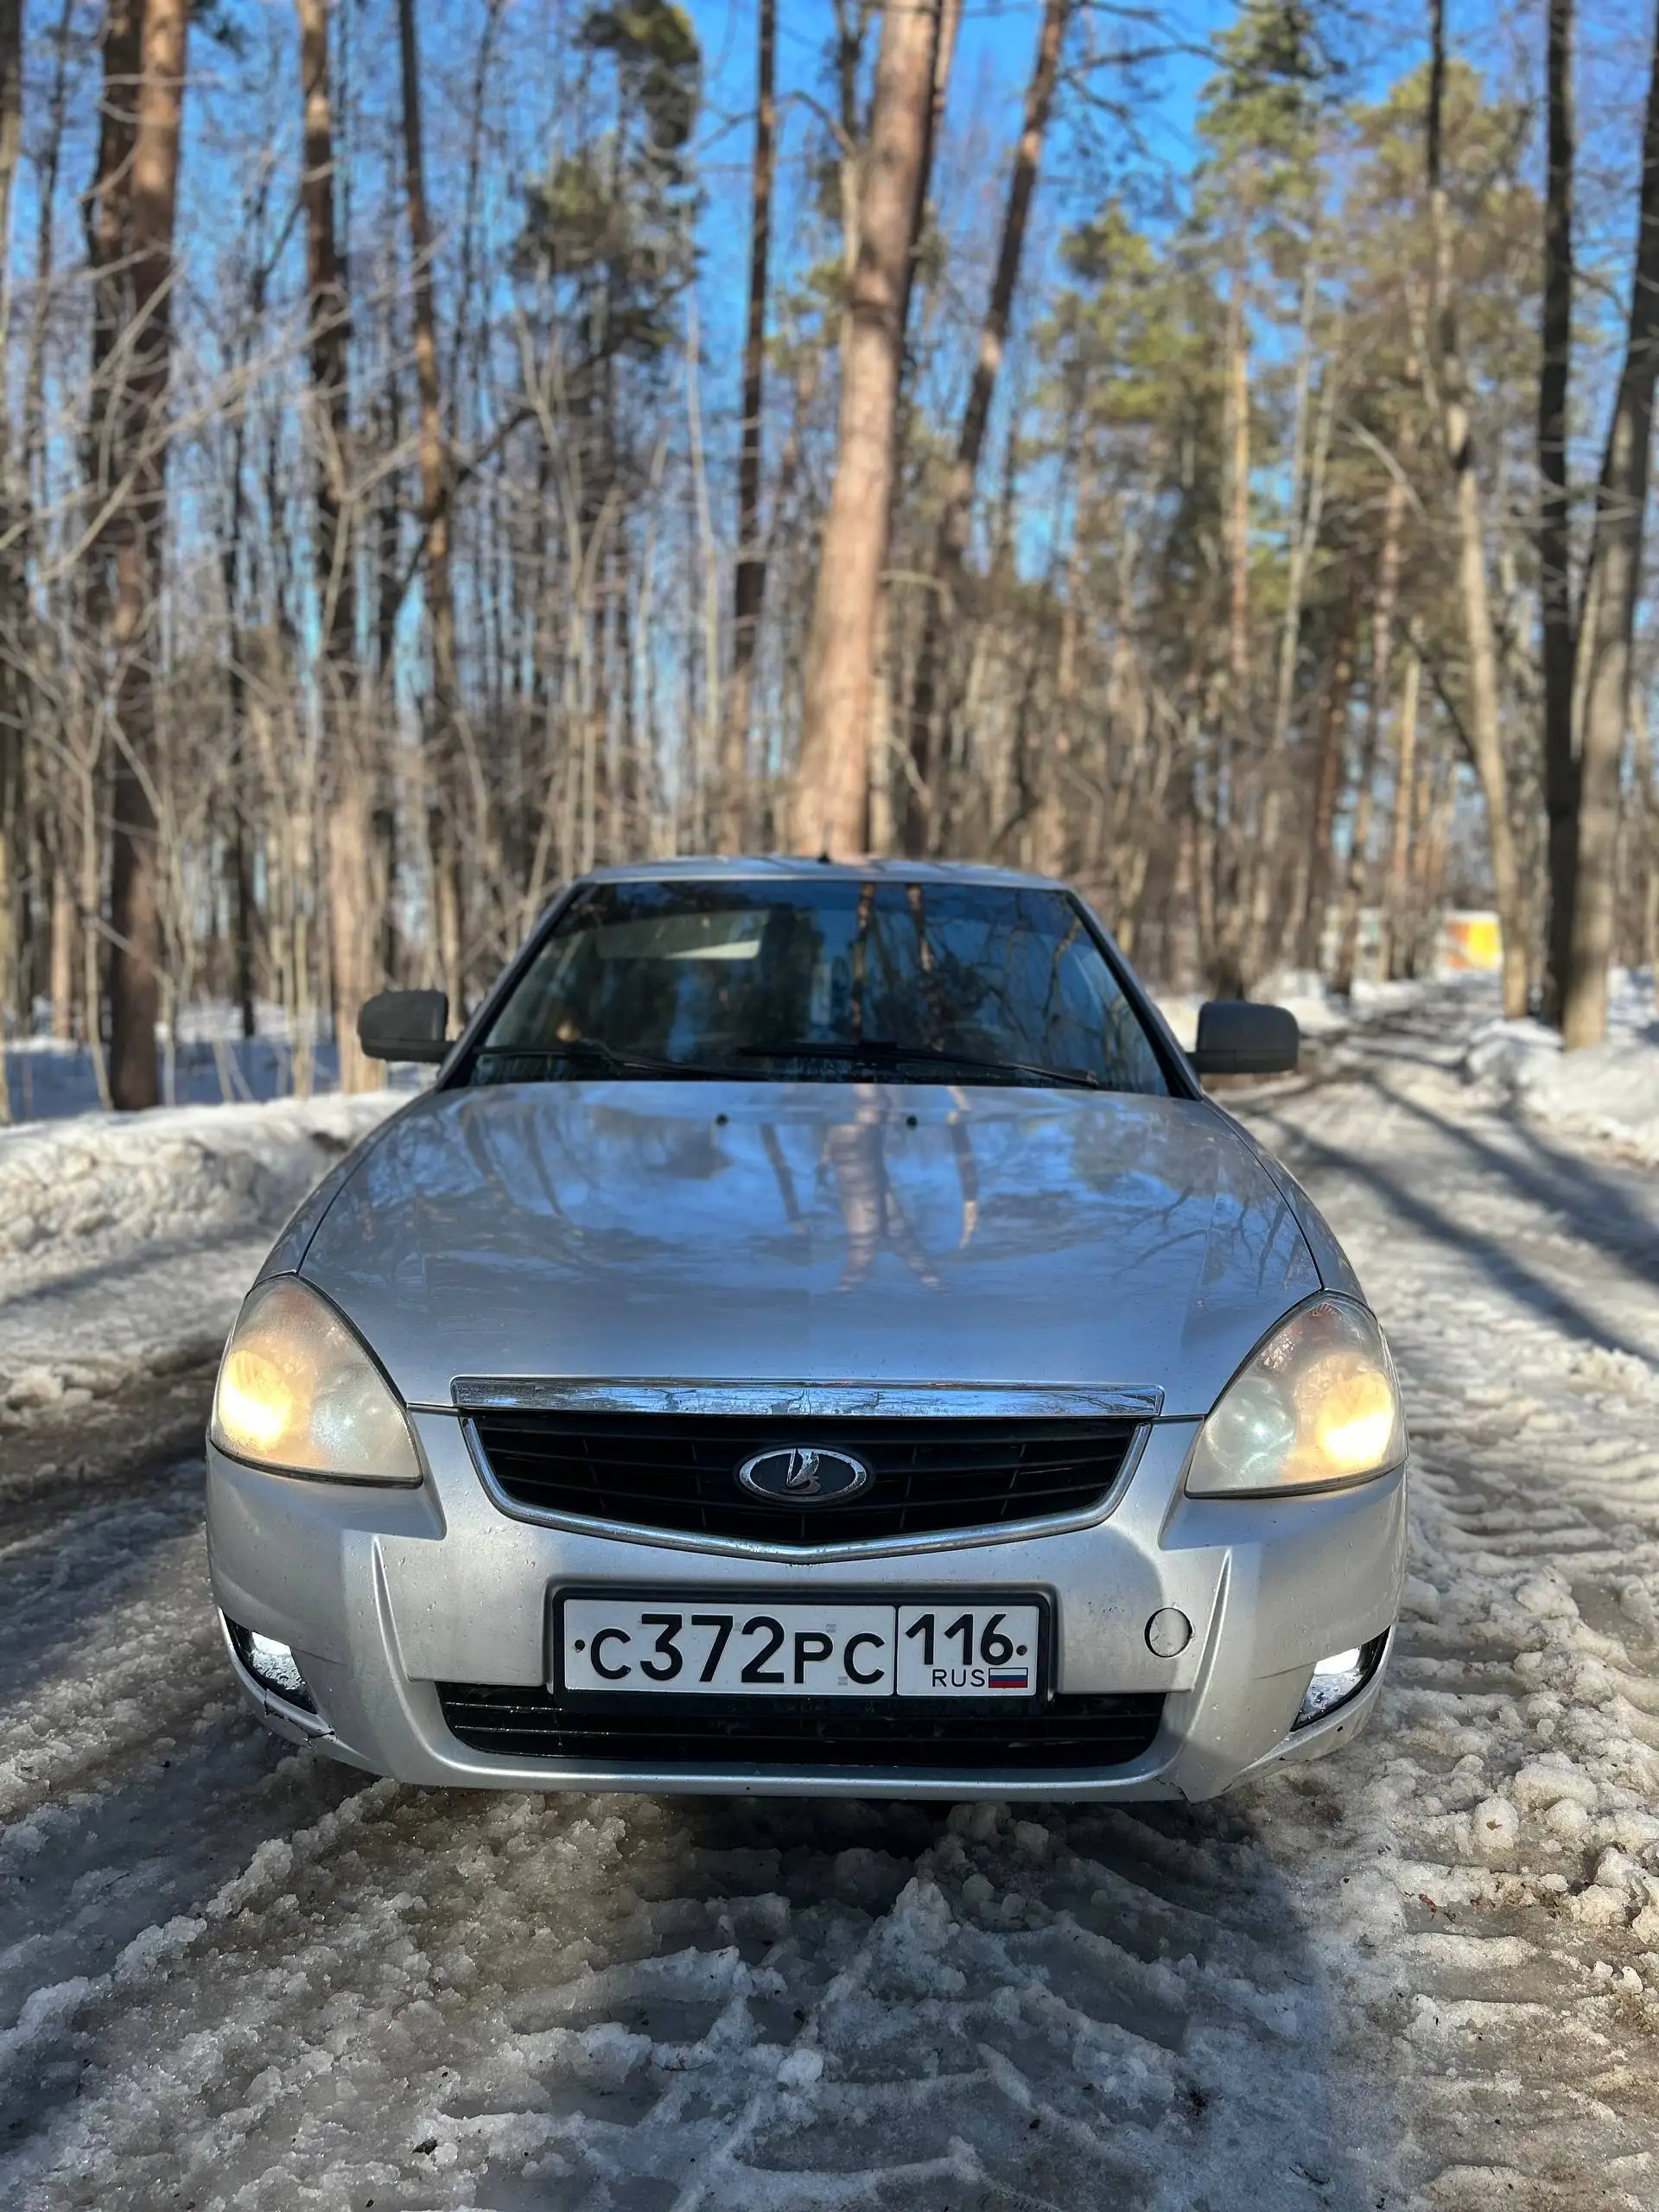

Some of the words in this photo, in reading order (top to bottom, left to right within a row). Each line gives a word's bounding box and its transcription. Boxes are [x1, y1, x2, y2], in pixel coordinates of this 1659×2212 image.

[590, 1613, 886, 1685] С372РС
[906, 1613, 1013, 1666] 116
[931, 1669, 986, 1688] RUS
